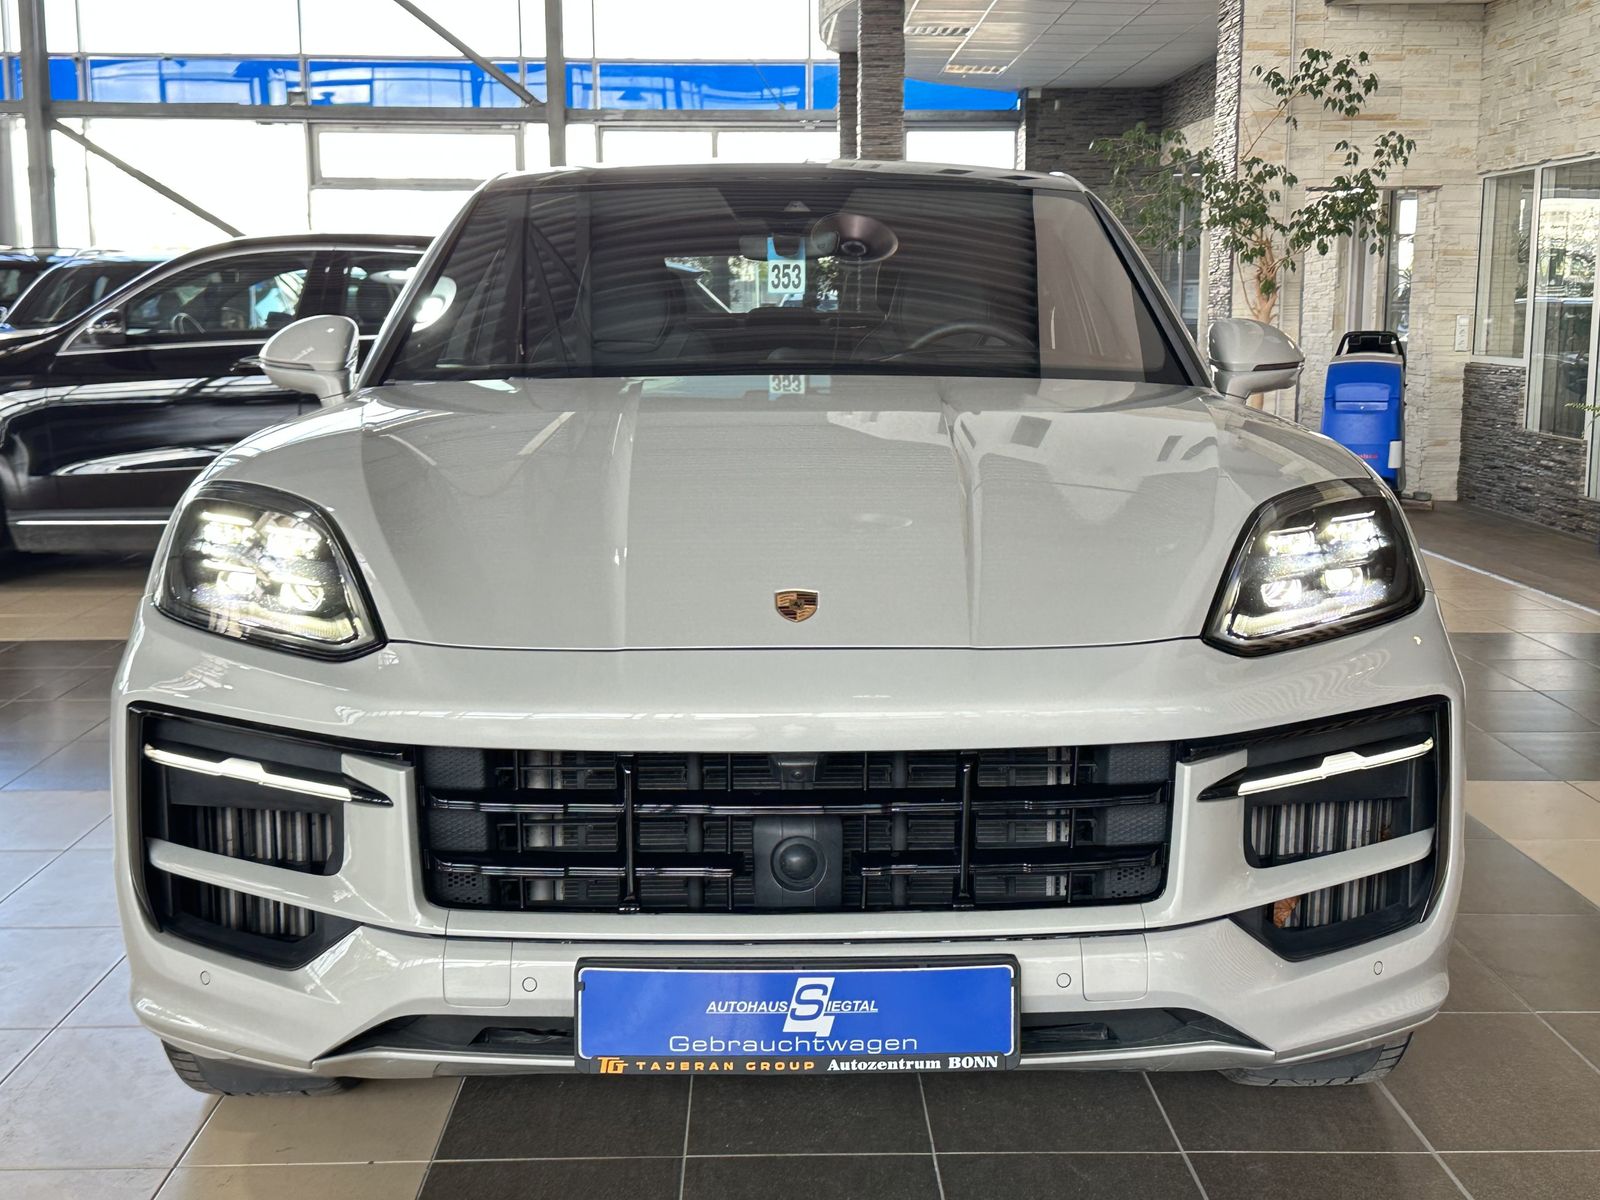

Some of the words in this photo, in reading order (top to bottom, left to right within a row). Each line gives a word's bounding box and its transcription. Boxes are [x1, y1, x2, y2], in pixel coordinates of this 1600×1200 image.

[771, 264, 802, 289] 353
[706, 1000, 789, 1013] AUTOHAUS
[668, 1035, 918, 1055] Gebrauchtwagen
[746, 1061, 816, 1071] GROUP
[827, 1058, 942, 1071] Autozentrum
[948, 1055, 999, 1069] BONN
